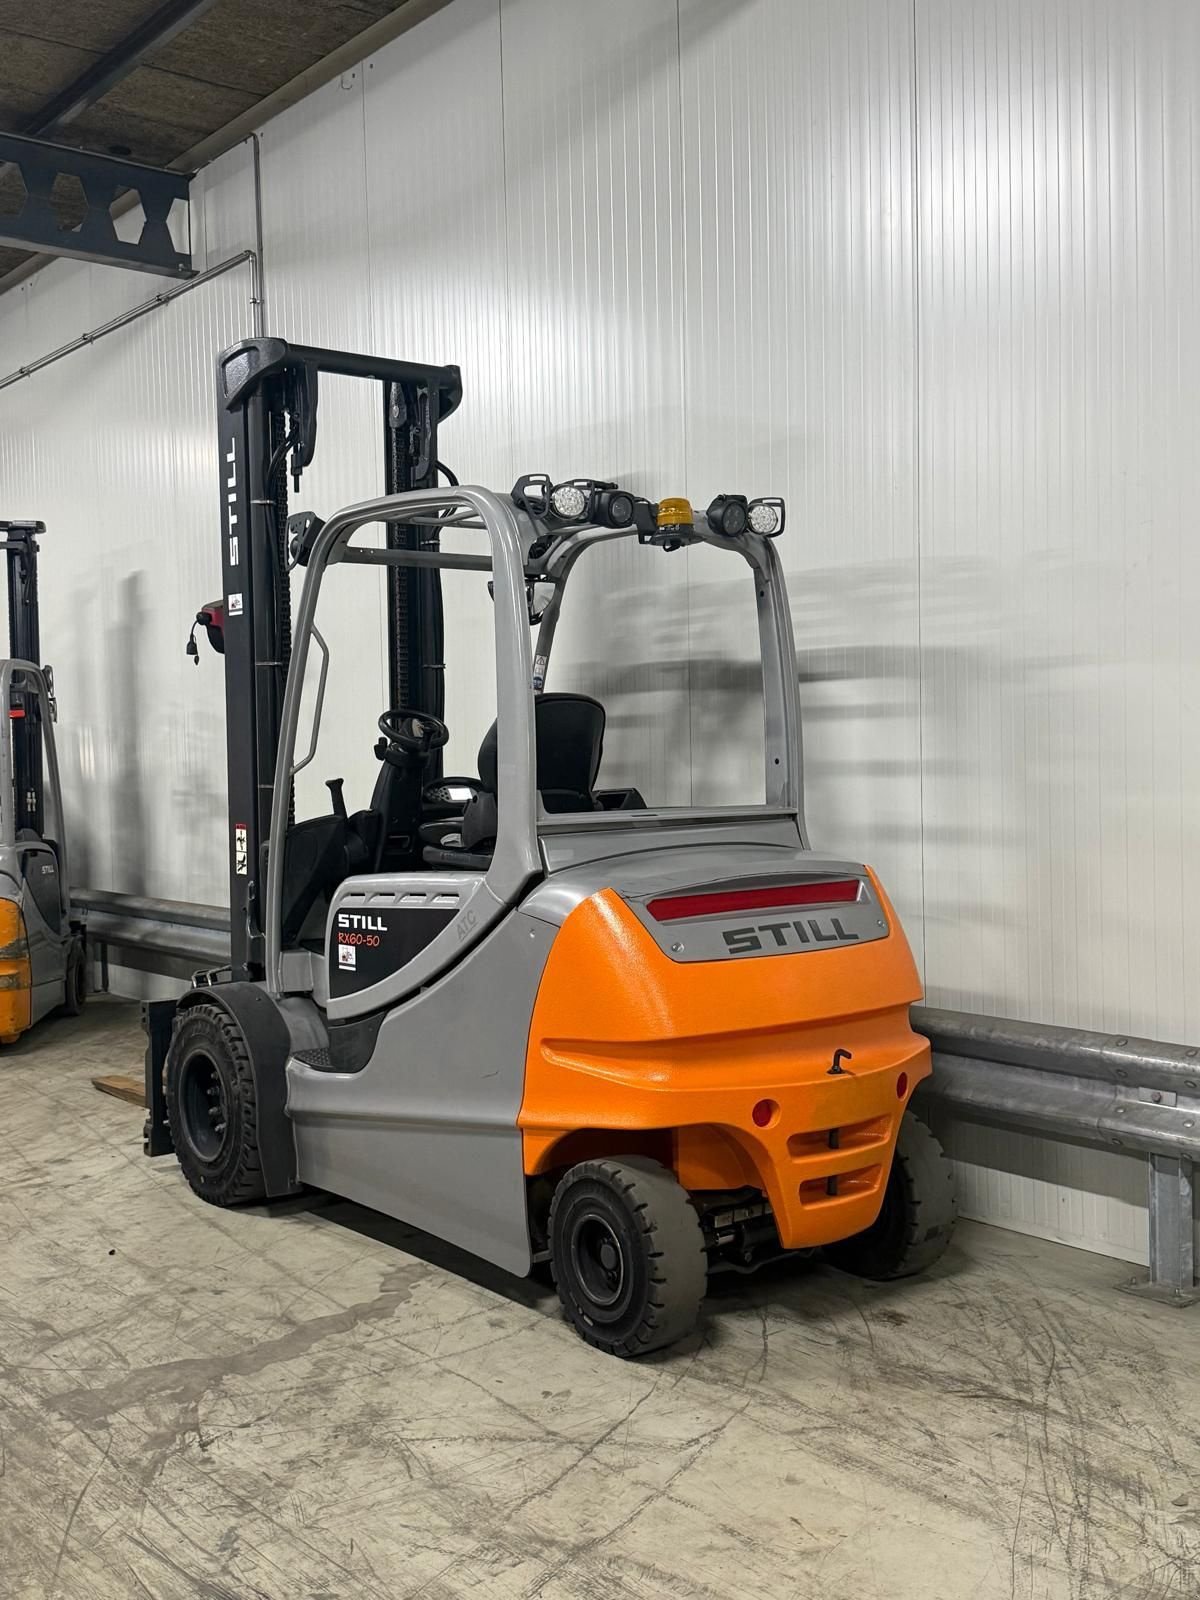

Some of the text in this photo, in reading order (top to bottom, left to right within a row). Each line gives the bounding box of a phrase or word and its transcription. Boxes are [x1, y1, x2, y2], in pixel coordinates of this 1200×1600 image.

[226, 437, 239, 567] STILL
[338, 913, 388, 931] STILL
[338, 932, 380, 947] RX60-50
[722, 918, 859, 955] STILL
